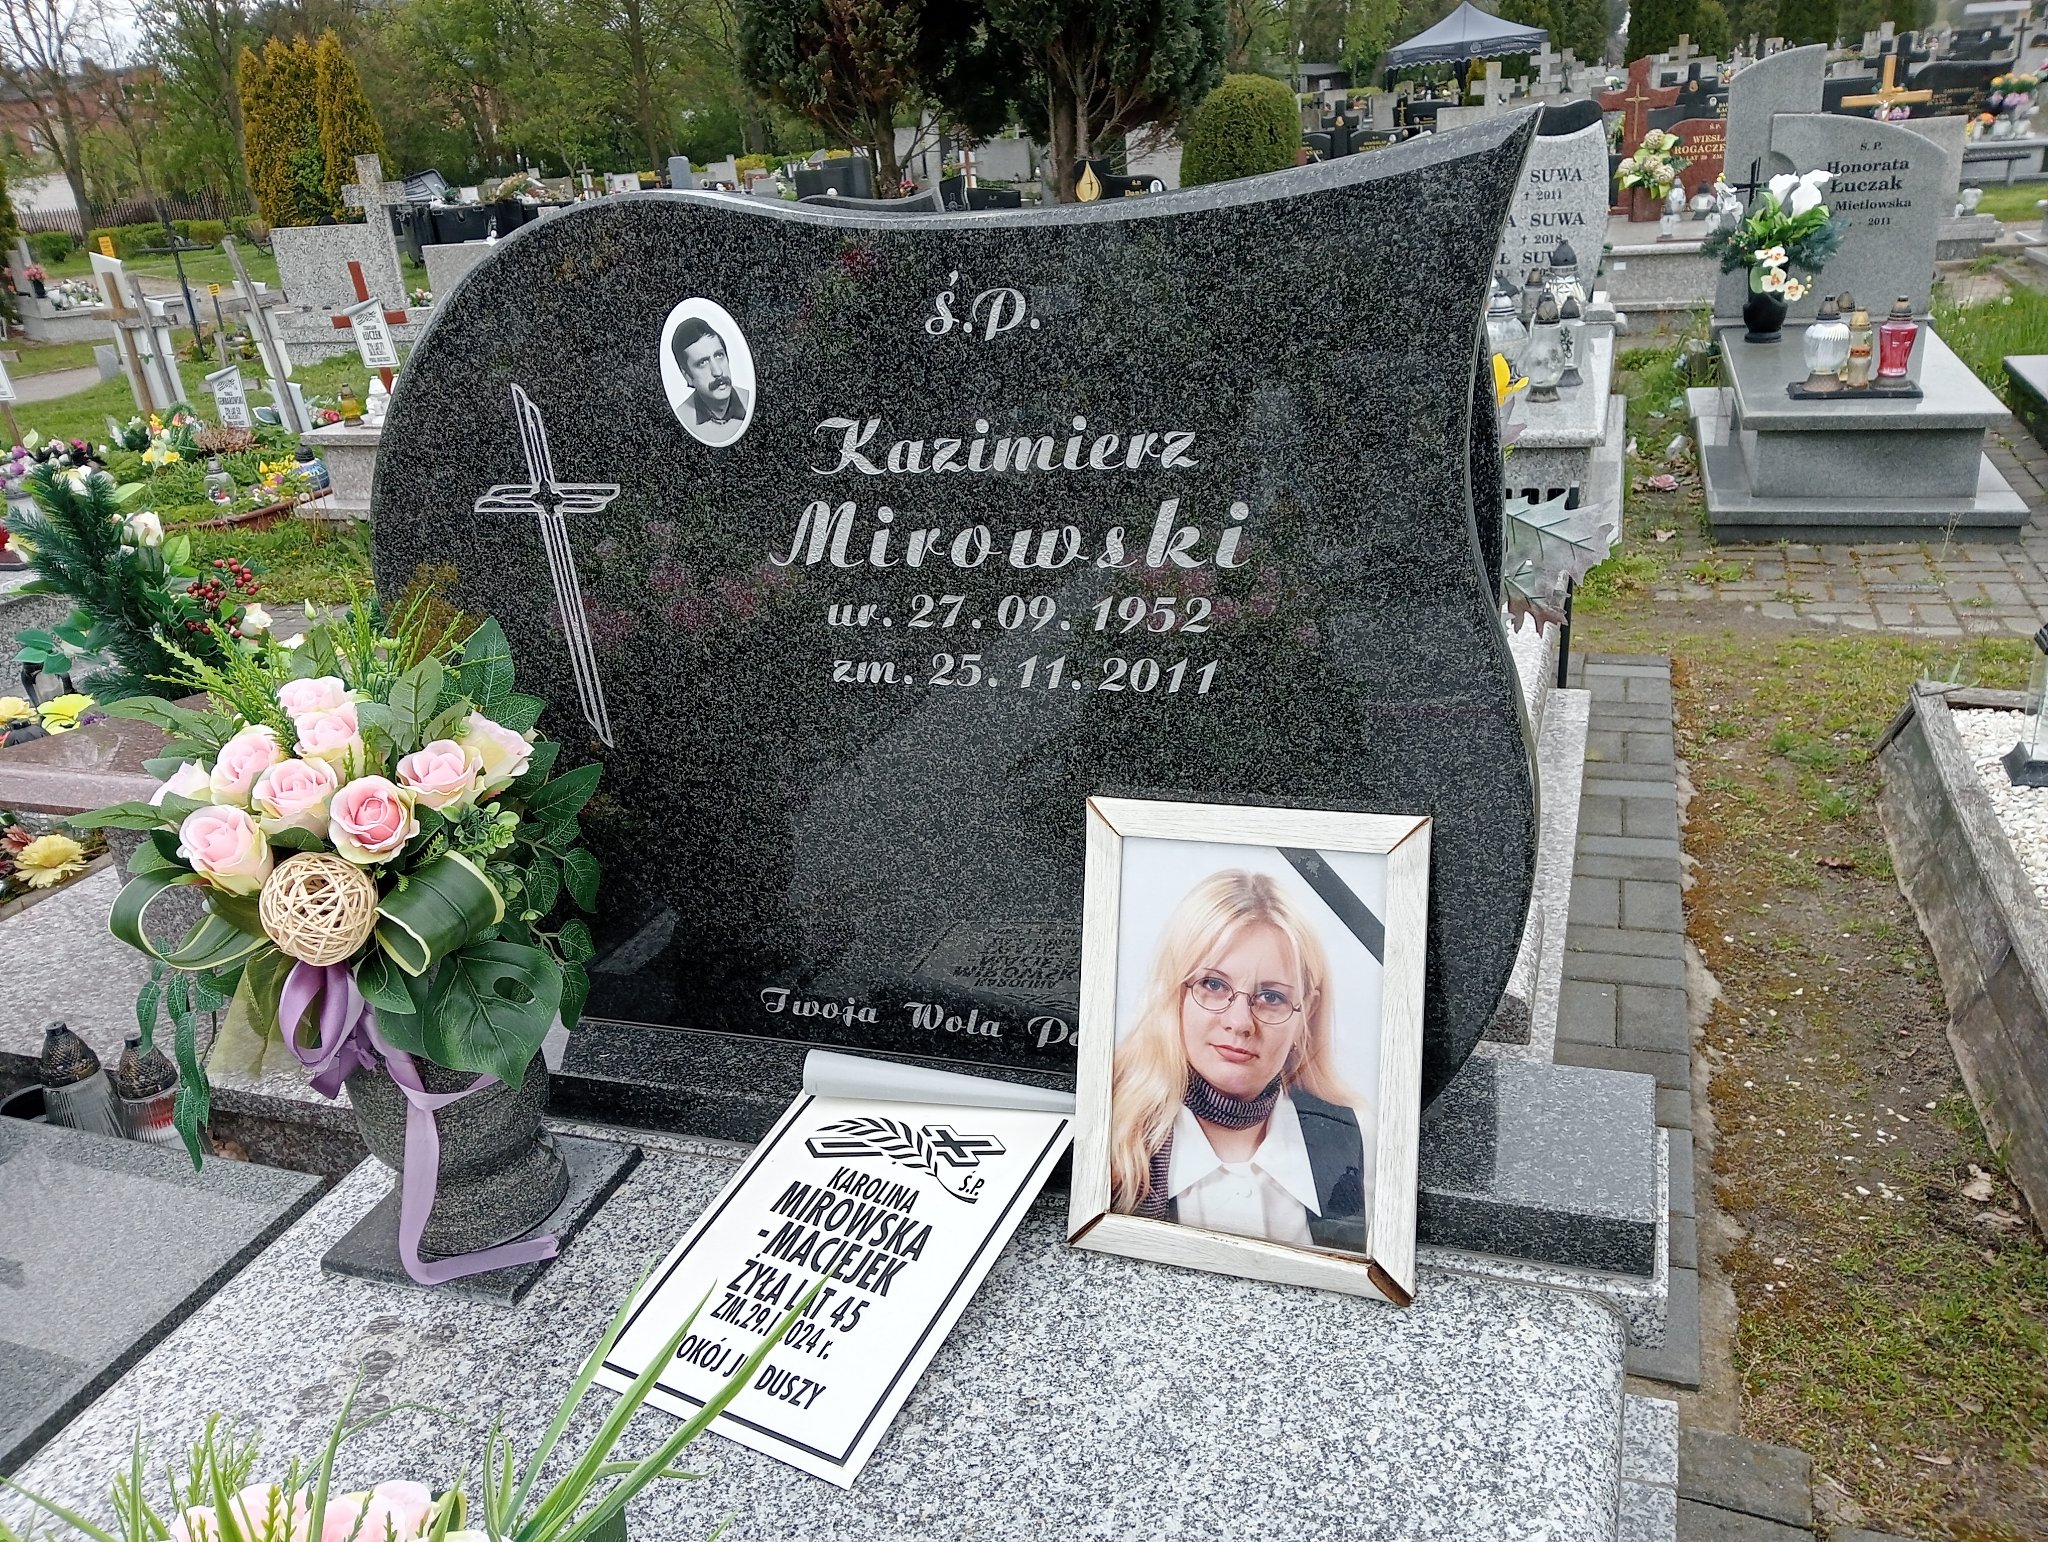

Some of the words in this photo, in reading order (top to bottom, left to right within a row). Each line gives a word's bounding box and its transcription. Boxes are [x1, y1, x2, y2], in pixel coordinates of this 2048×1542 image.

[1530, 167, 1583, 183] SUWA
[1827, 158, 1910, 174] Honorata
[1830, 175, 1903, 194] Łuczak
[1536, 190, 1562, 201] 2011
[1530, 212, 1586, 227] SUWA
[1868, 217, 1891, 226] 2011
[1522, 250, 1554, 264] SU
[811, 415, 1200, 475] Kazimierz
[769, 498, 1251, 569] Mirowski
[828, 600, 892, 628] ur.
[1091, 596, 1212, 634] 1952
[833, 659, 913, 686] zm.
[1098, 658, 1219, 695] 2011
[760, 987, 880, 1026] Twoja
[903, 1002, 1003, 1038] Wola
[827, 1166, 920, 1214] KAROLINA
[958, 1171, 985, 1197] Ś.P.
[770, 1181, 933, 1262] MIROWSKA
[758, 1221, 908, 1297] -MACIEJEK
[727, 1253, 792, 1305] ŻYŁA
[829, 1296, 869, 1333] 45
[671, 1331, 732, 1372] OKÓJ
[754, 1364, 827, 1410] DUSZY
